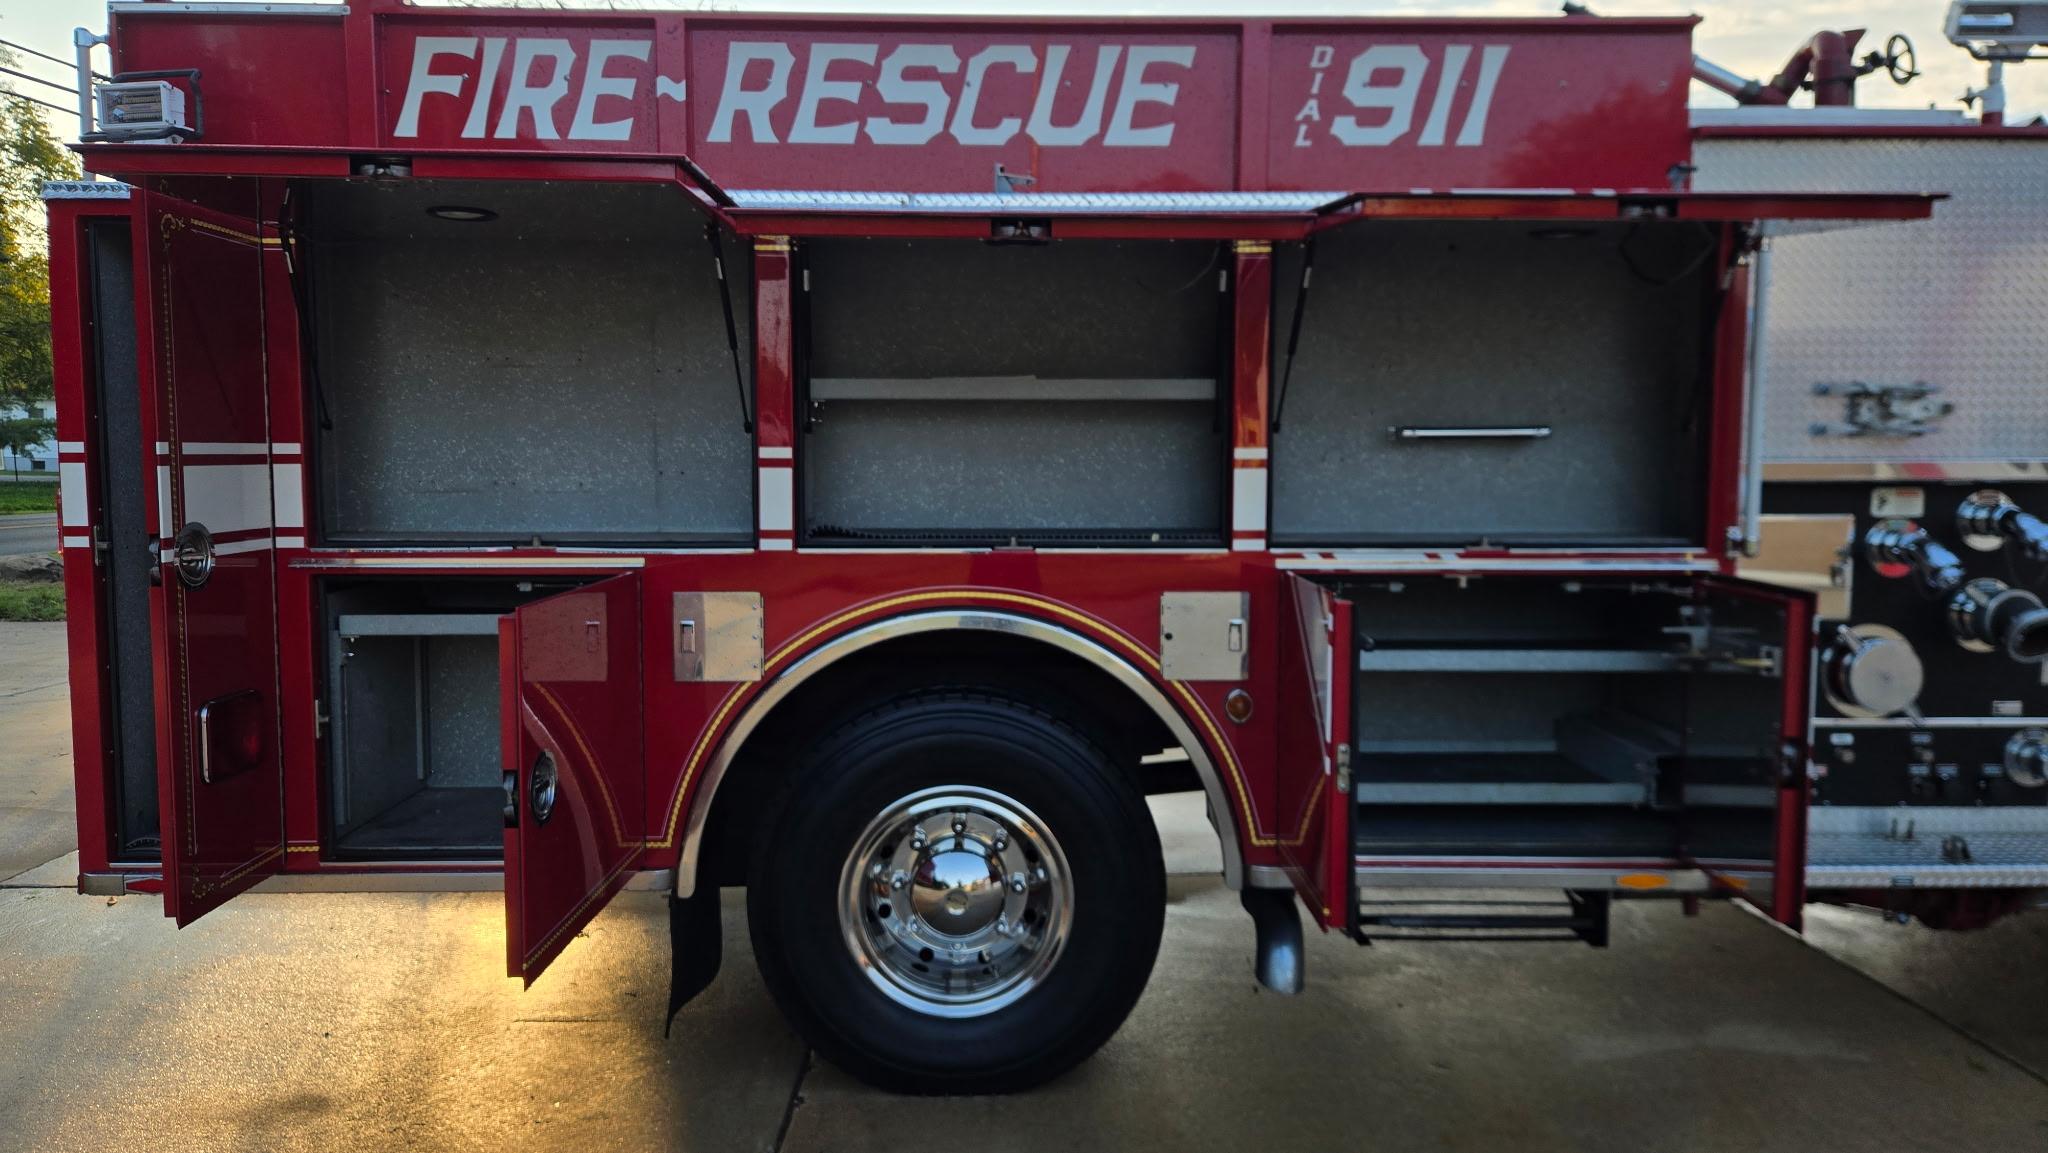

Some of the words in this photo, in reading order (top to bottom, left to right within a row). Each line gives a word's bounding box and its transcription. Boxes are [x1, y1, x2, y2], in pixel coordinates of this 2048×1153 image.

[706, 41, 1196, 147] RESCUE
[1295, 46, 1334, 148] DIAL
[1330, 45, 1510, 147] 911
